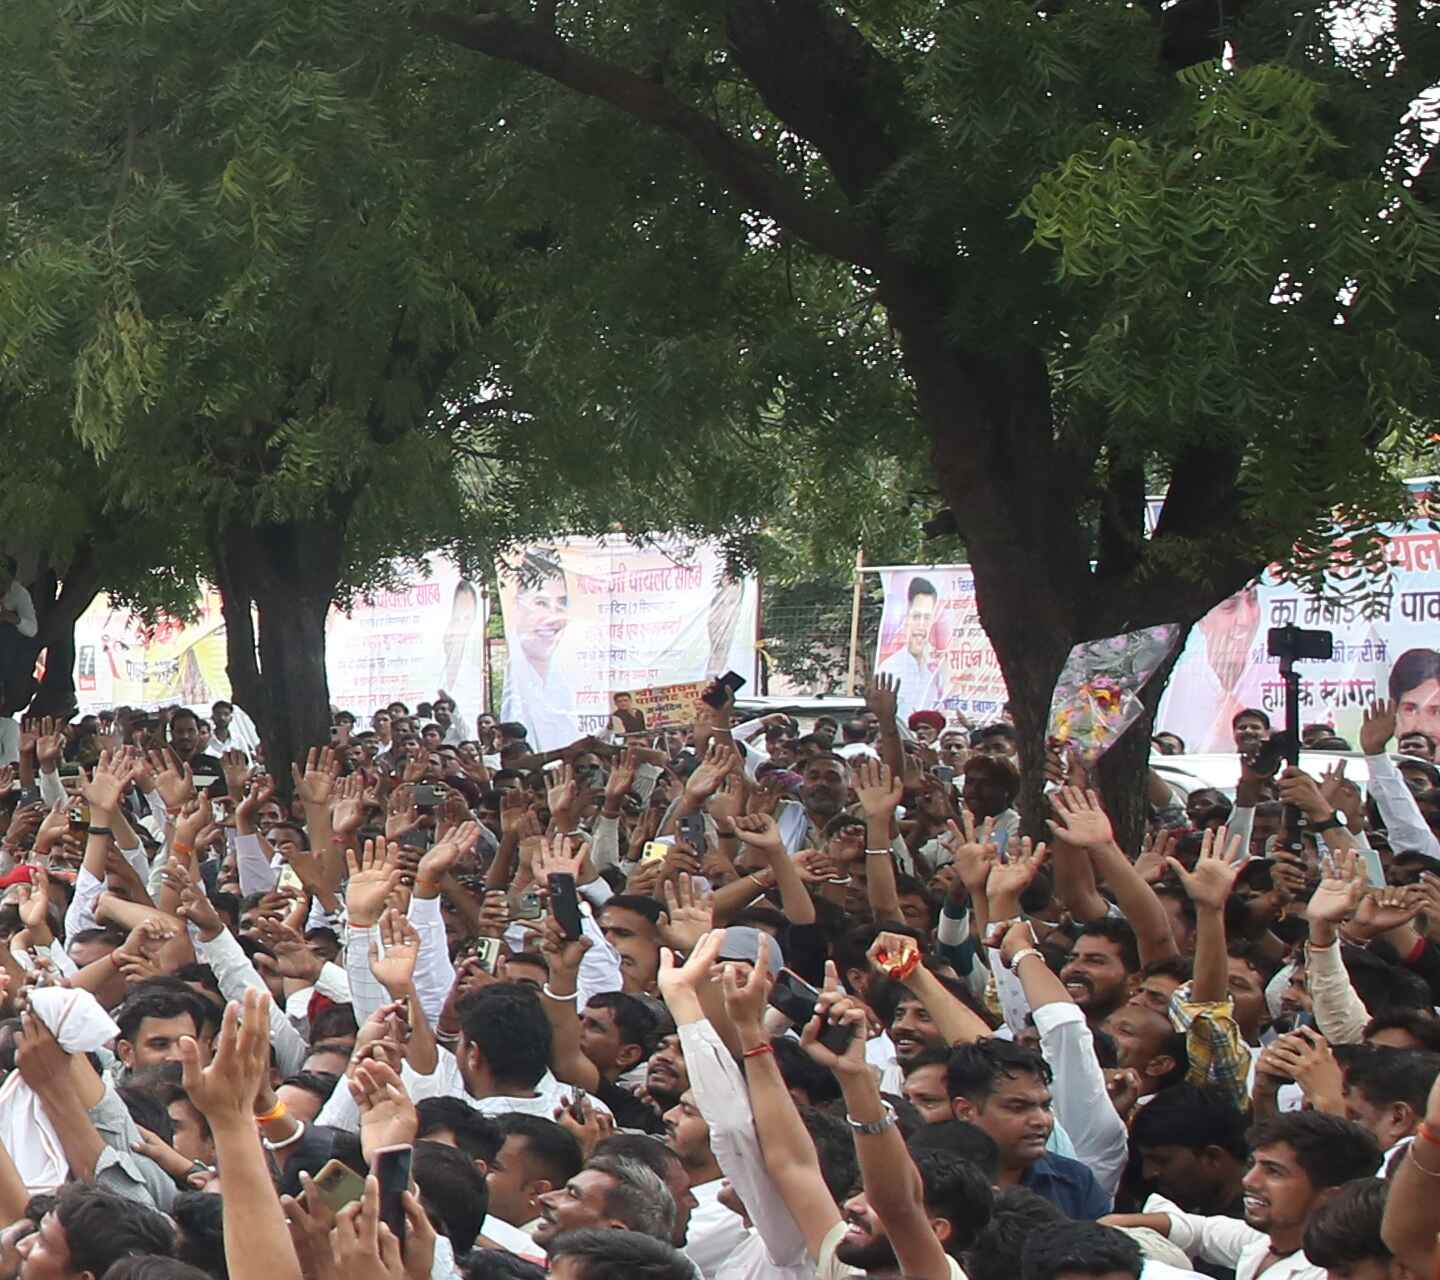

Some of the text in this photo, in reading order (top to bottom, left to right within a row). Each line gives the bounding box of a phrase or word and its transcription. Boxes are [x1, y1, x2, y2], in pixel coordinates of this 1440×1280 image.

[629, 568, 673, 593] पायलट
[1270, 598, 1298, 627] का
[1401, 591, 1440, 622] पाव
[1320, 677, 1377, 709] स्वागत
